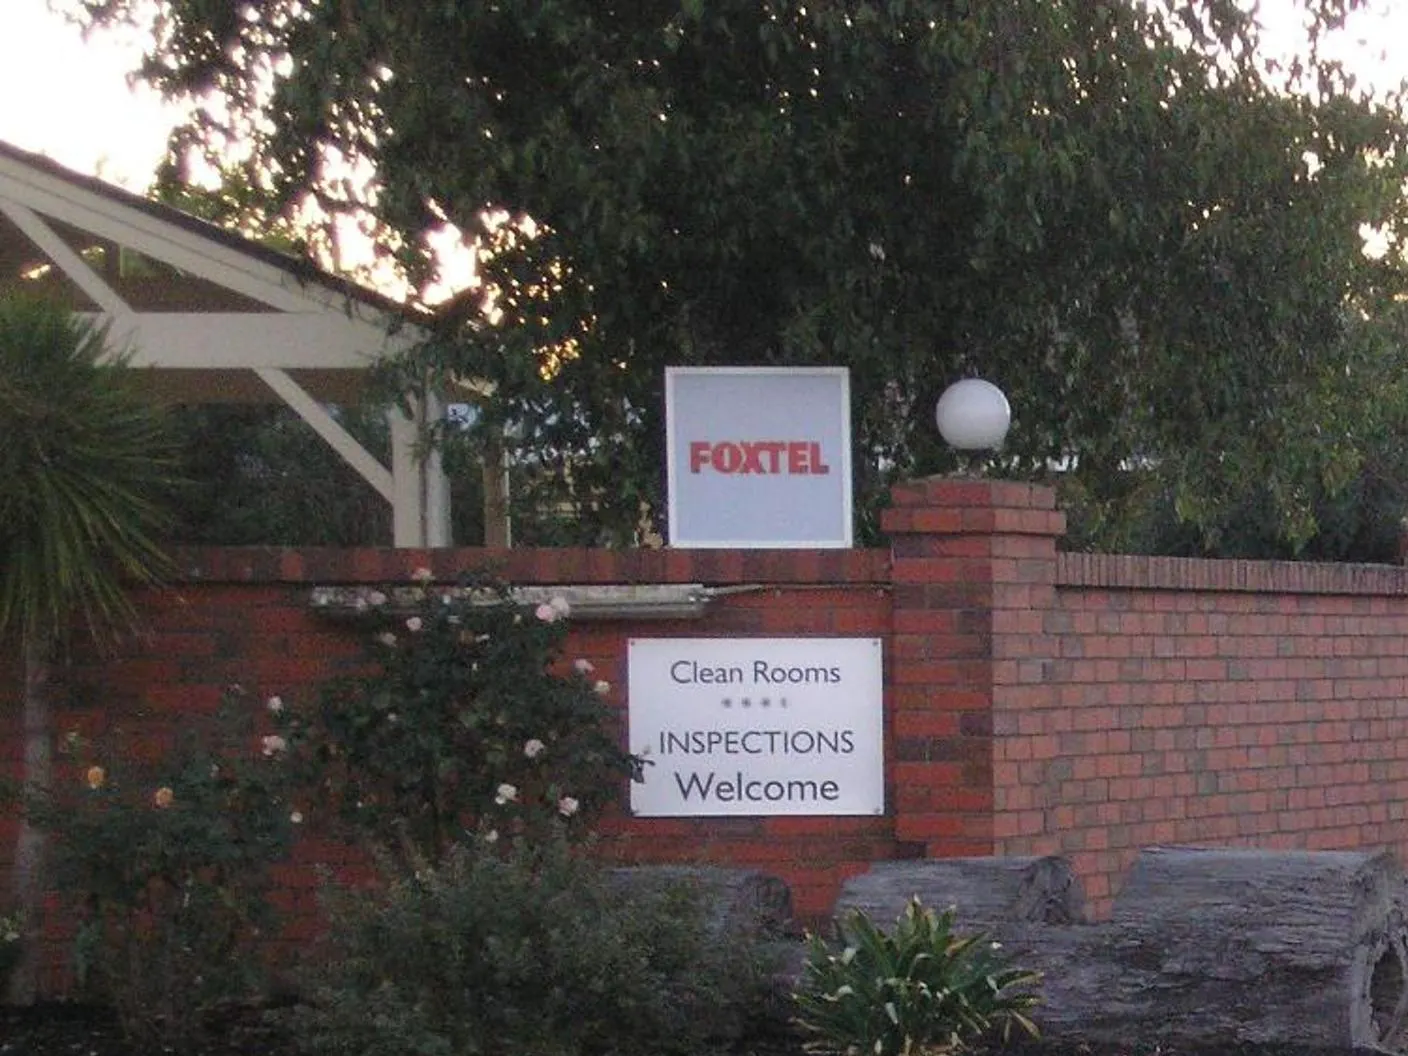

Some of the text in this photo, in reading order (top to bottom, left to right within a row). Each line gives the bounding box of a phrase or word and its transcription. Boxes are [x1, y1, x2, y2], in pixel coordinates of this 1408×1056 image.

[690, 441, 829, 475] FOXTEL
[670, 660, 841, 685] Clean Rooms
[659, 730, 855, 755] INSPECTIONS
[674, 771, 840, 802] Welcome
